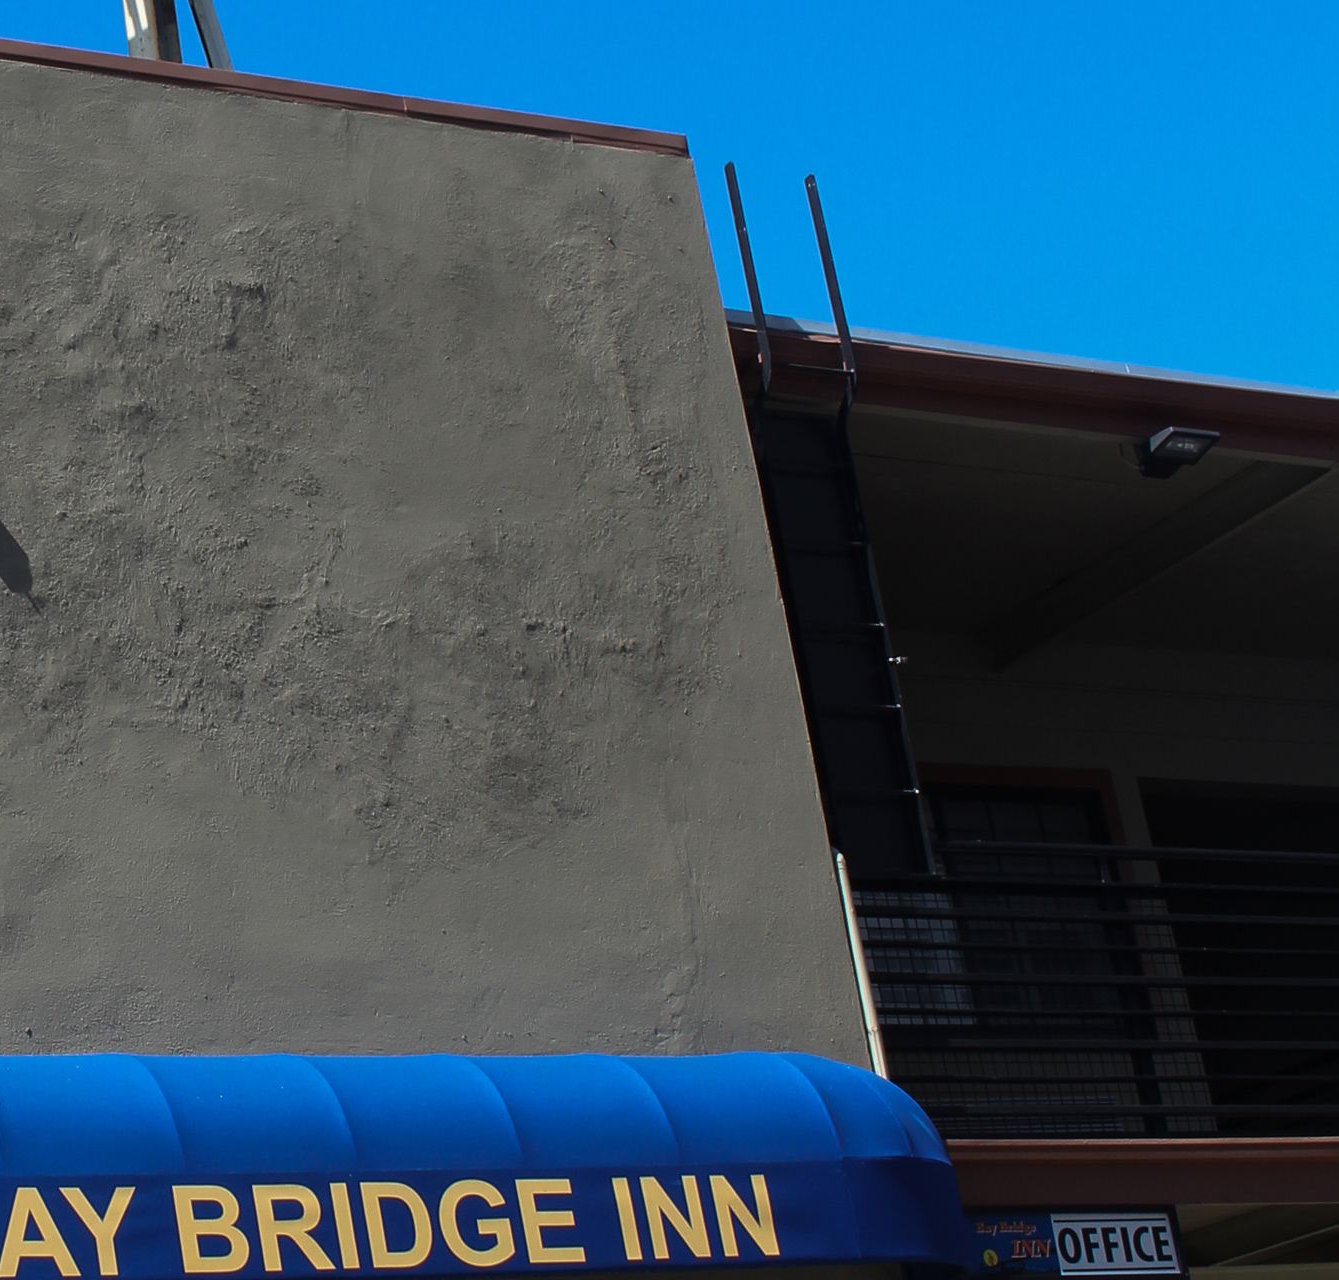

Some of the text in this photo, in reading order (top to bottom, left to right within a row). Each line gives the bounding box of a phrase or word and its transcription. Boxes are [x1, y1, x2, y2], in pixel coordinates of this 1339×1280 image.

[171, 1178, 587, 1274] BRIDGE
[611, 1174, 781, 1262] INN
[1011, 1238, 1051, 1258] INN
[1058, 1226, 1173, 1264] OFFICE
